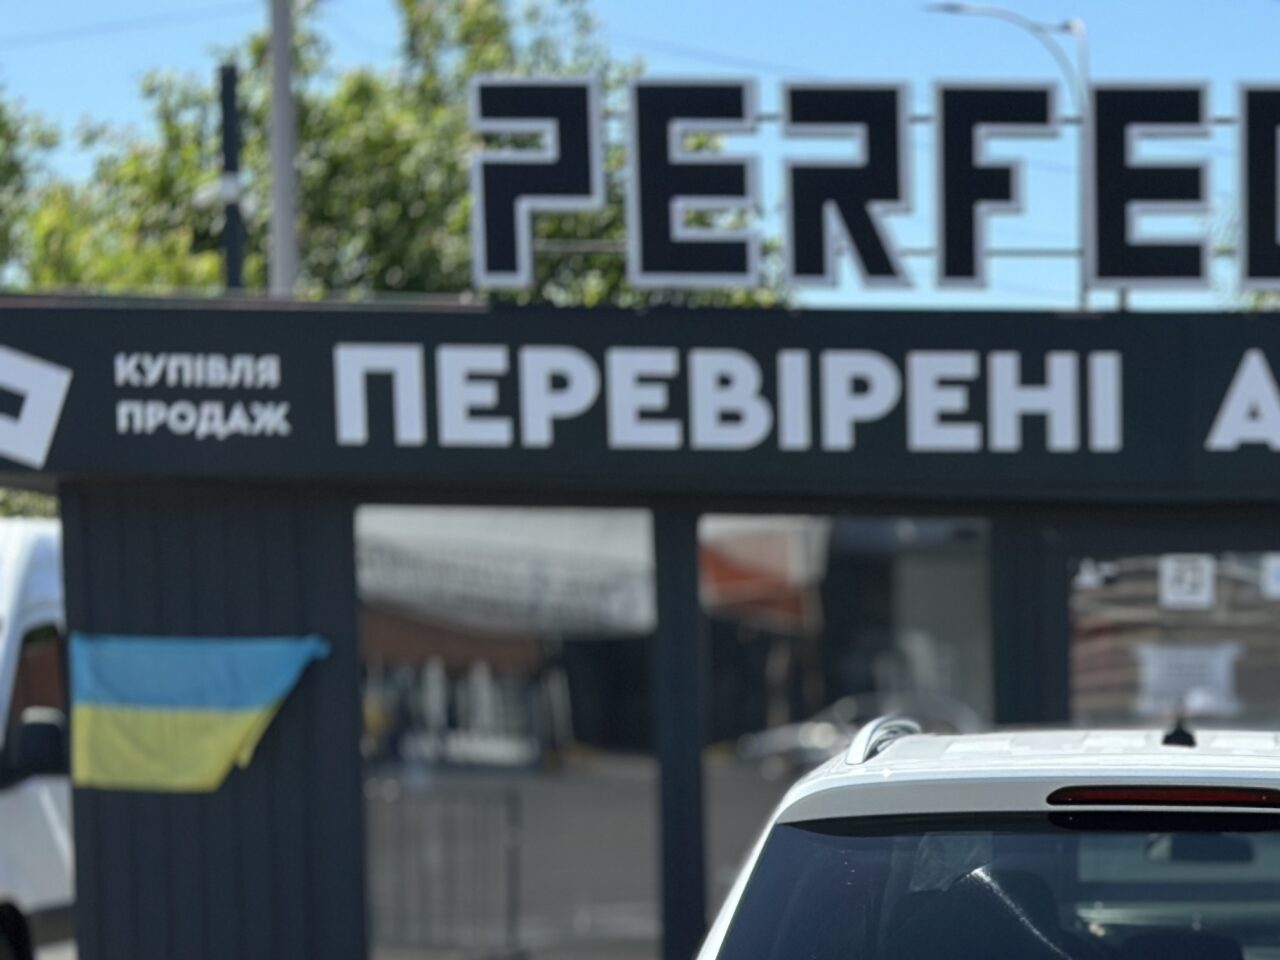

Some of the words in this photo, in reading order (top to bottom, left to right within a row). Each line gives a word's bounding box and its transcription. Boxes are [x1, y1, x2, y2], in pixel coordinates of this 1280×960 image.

[113, 353, 281, 389] КУПІВЛЯ
[332, 342, 1124, 453] ПЕРЕВІРЕНІ
[115, 400, 291, 440] ПРОДАЖ
